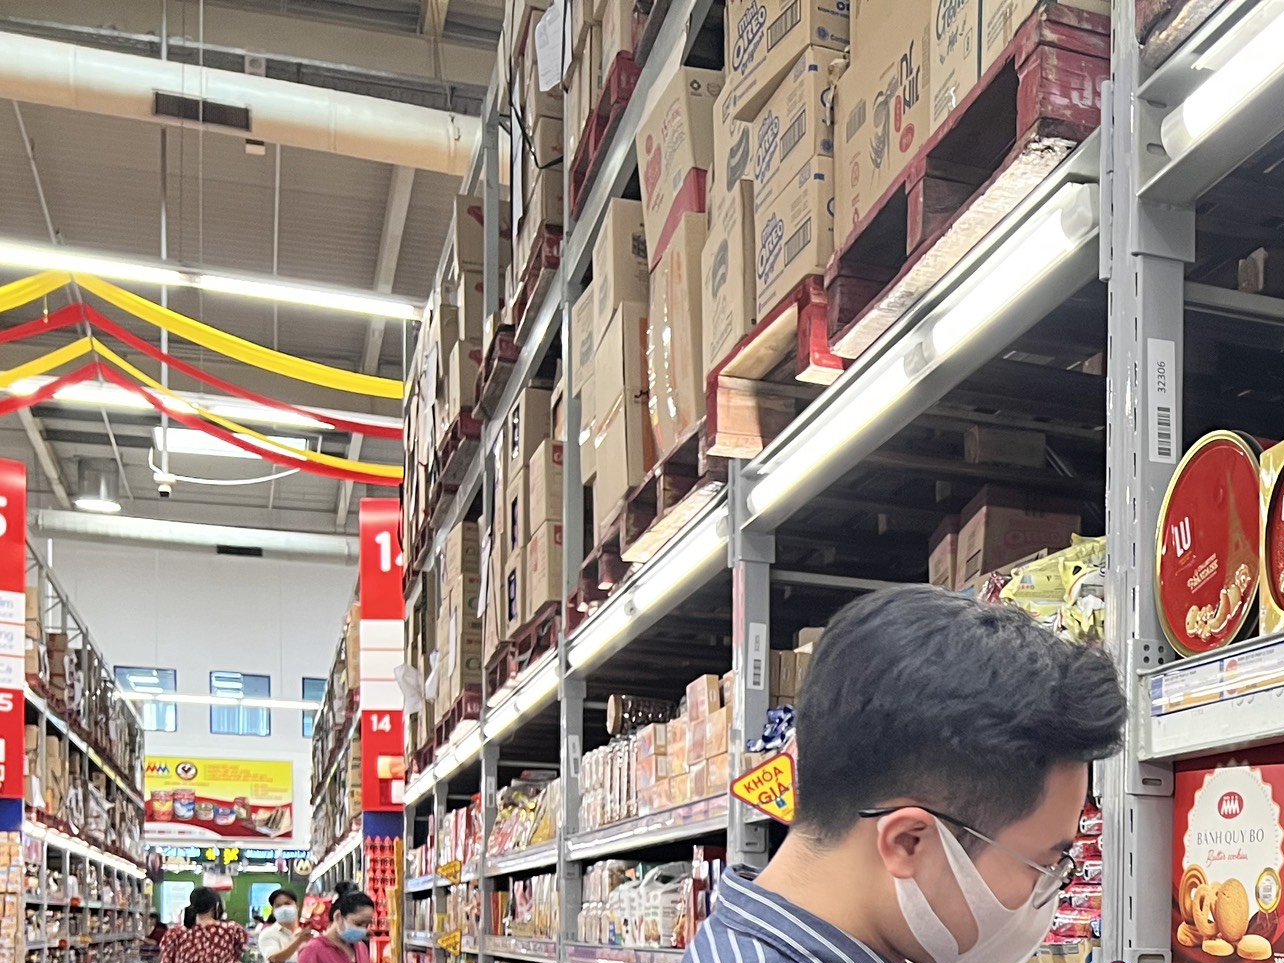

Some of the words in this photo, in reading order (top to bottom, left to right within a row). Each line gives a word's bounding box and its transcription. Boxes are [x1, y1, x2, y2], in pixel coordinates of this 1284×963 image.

[738, 3, 757, 35] mini
[732, 5, 768, 72] OREO
[755, 115, 780, 181] OREO
[757, 218, 785, 281] OREO
[1157, 360, 1167, 394] 32306
[371, 713, 391, 733] 14
[744, 766, 784, 794] KHÓA
[758, 779, 790, 806] GIÁ
